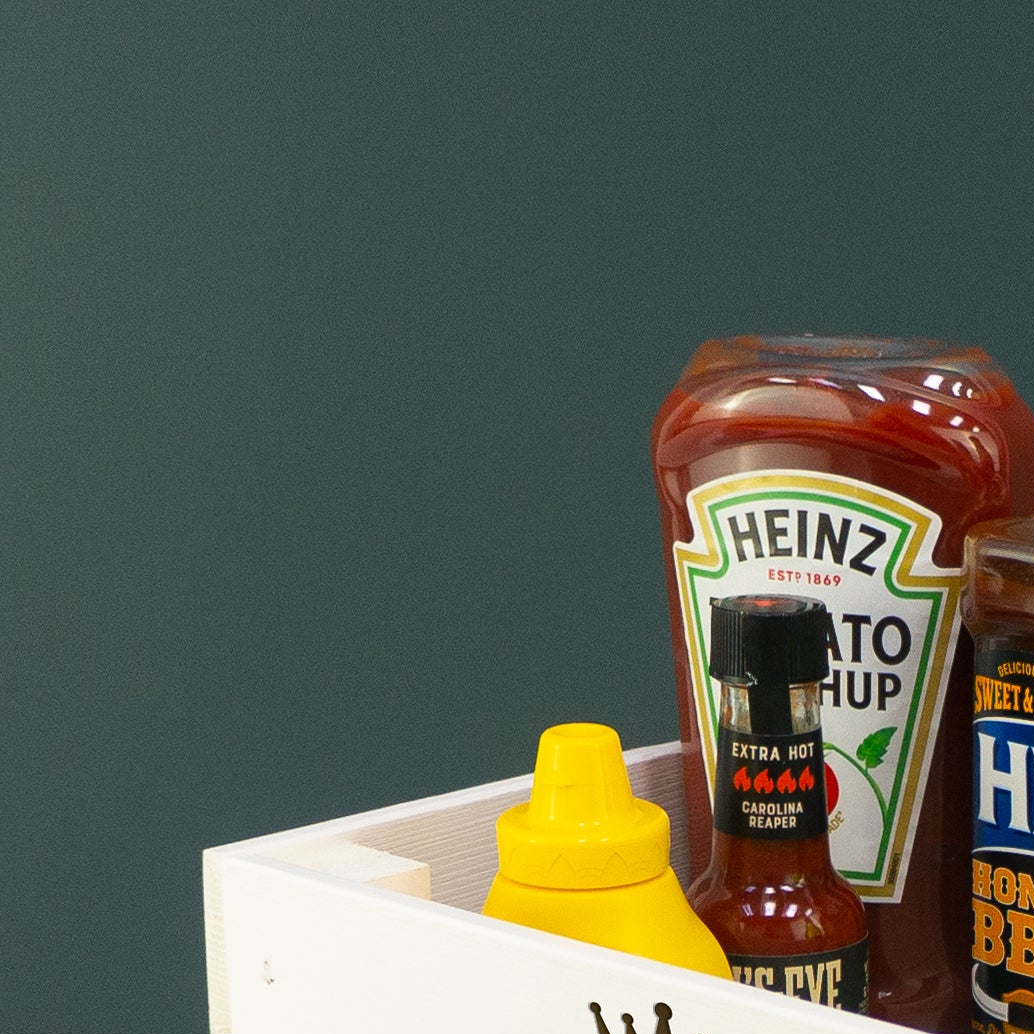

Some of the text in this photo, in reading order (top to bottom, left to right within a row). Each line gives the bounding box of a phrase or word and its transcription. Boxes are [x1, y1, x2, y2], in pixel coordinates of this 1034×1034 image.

[727, 509, 887, 577] HEINZ
[806, 572, 842, 587] 1869
[826, 612, 912, 666] ATO
[819, 670, 902, 711] HUP
[975, 675, 1021, 714] SWEET
[1023, 687, 1034, 713] &
[732, 742, 815, 762] EXTRA HOT
[742, 801, 804, 816] CAROLINA
[749, 815, 797, 829] REAPER
